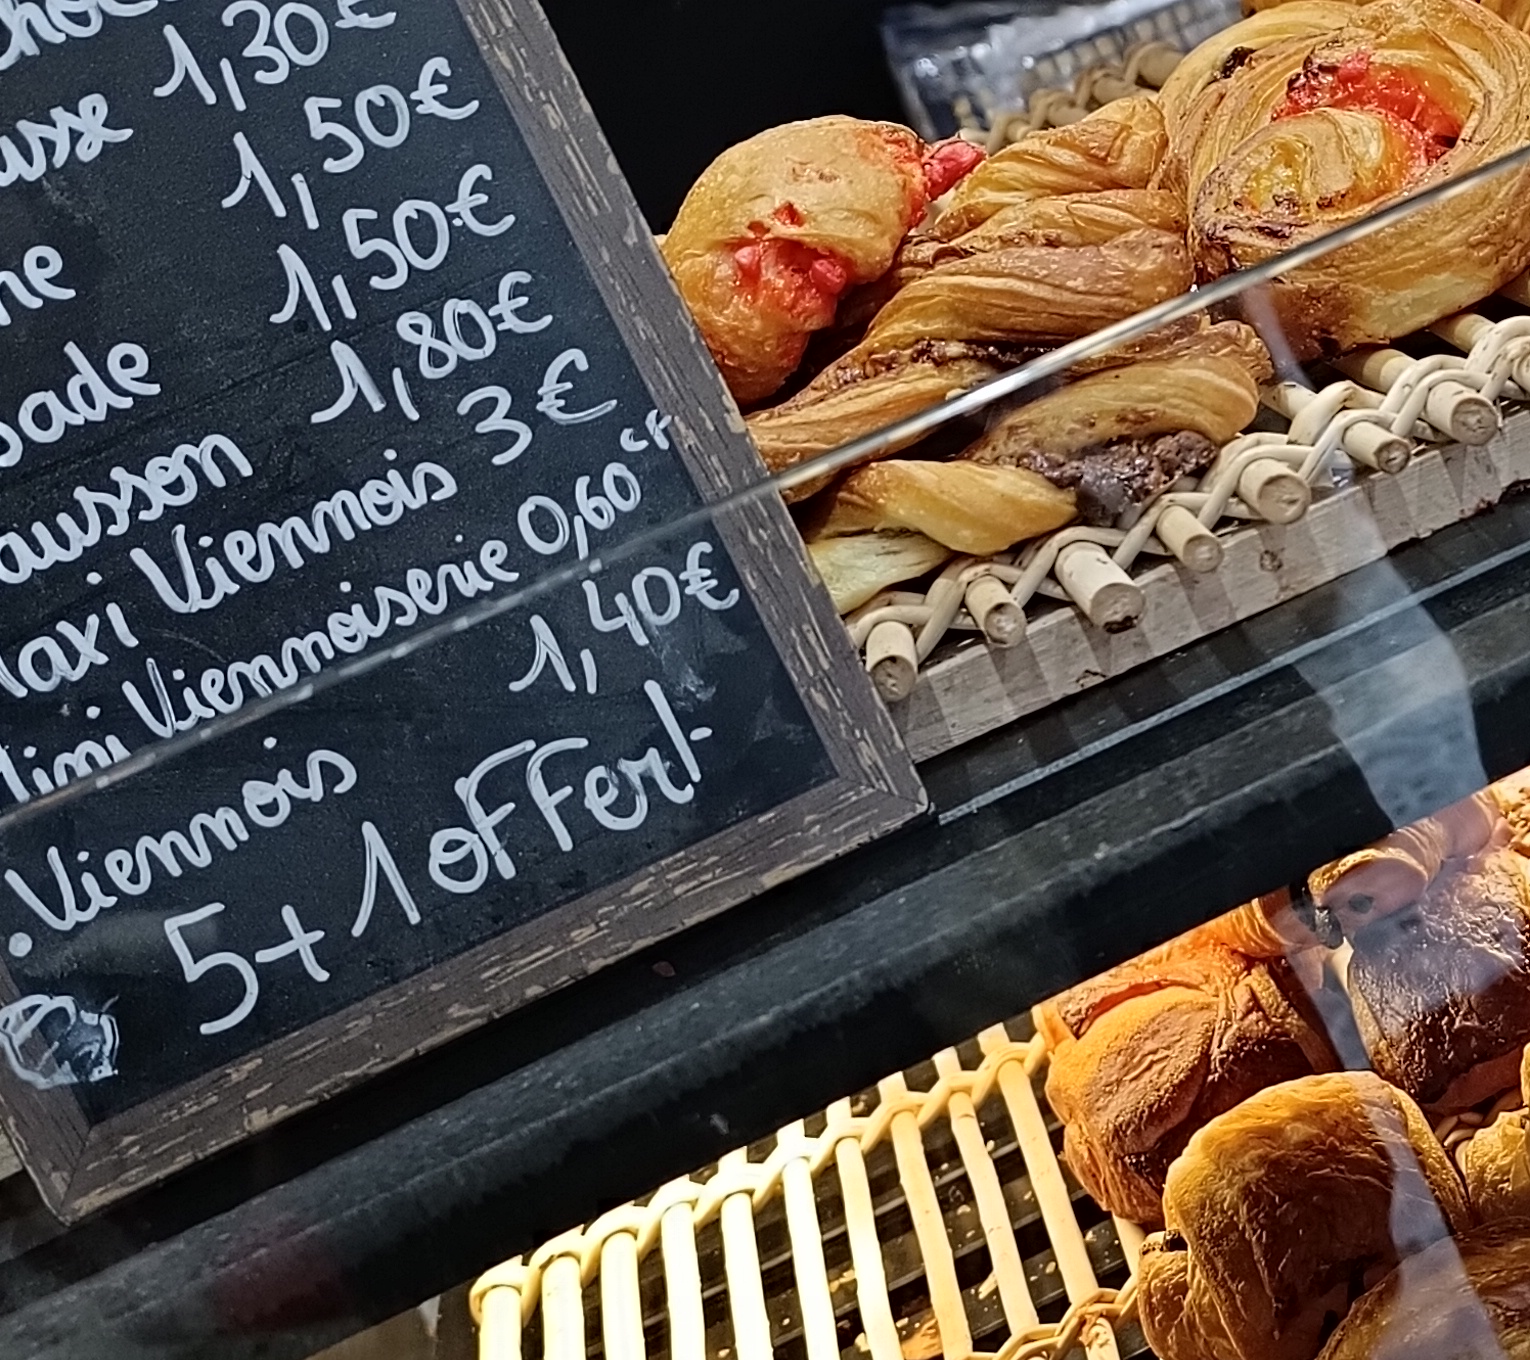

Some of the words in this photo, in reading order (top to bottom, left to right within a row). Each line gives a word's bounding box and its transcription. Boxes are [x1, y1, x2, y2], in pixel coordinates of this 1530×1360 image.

[221, 57, 480, 230] 1,50€
[269, 164, 516, 331] 1,50€
[312, 271, 554, 424] 1,80€
[130, 448, 457, 613] Viennois
[122, 533, 519, 739] Viennoiserie
[5, 737, 358, 931] Viennois
[509, 541, 739, 694] 1,40€
